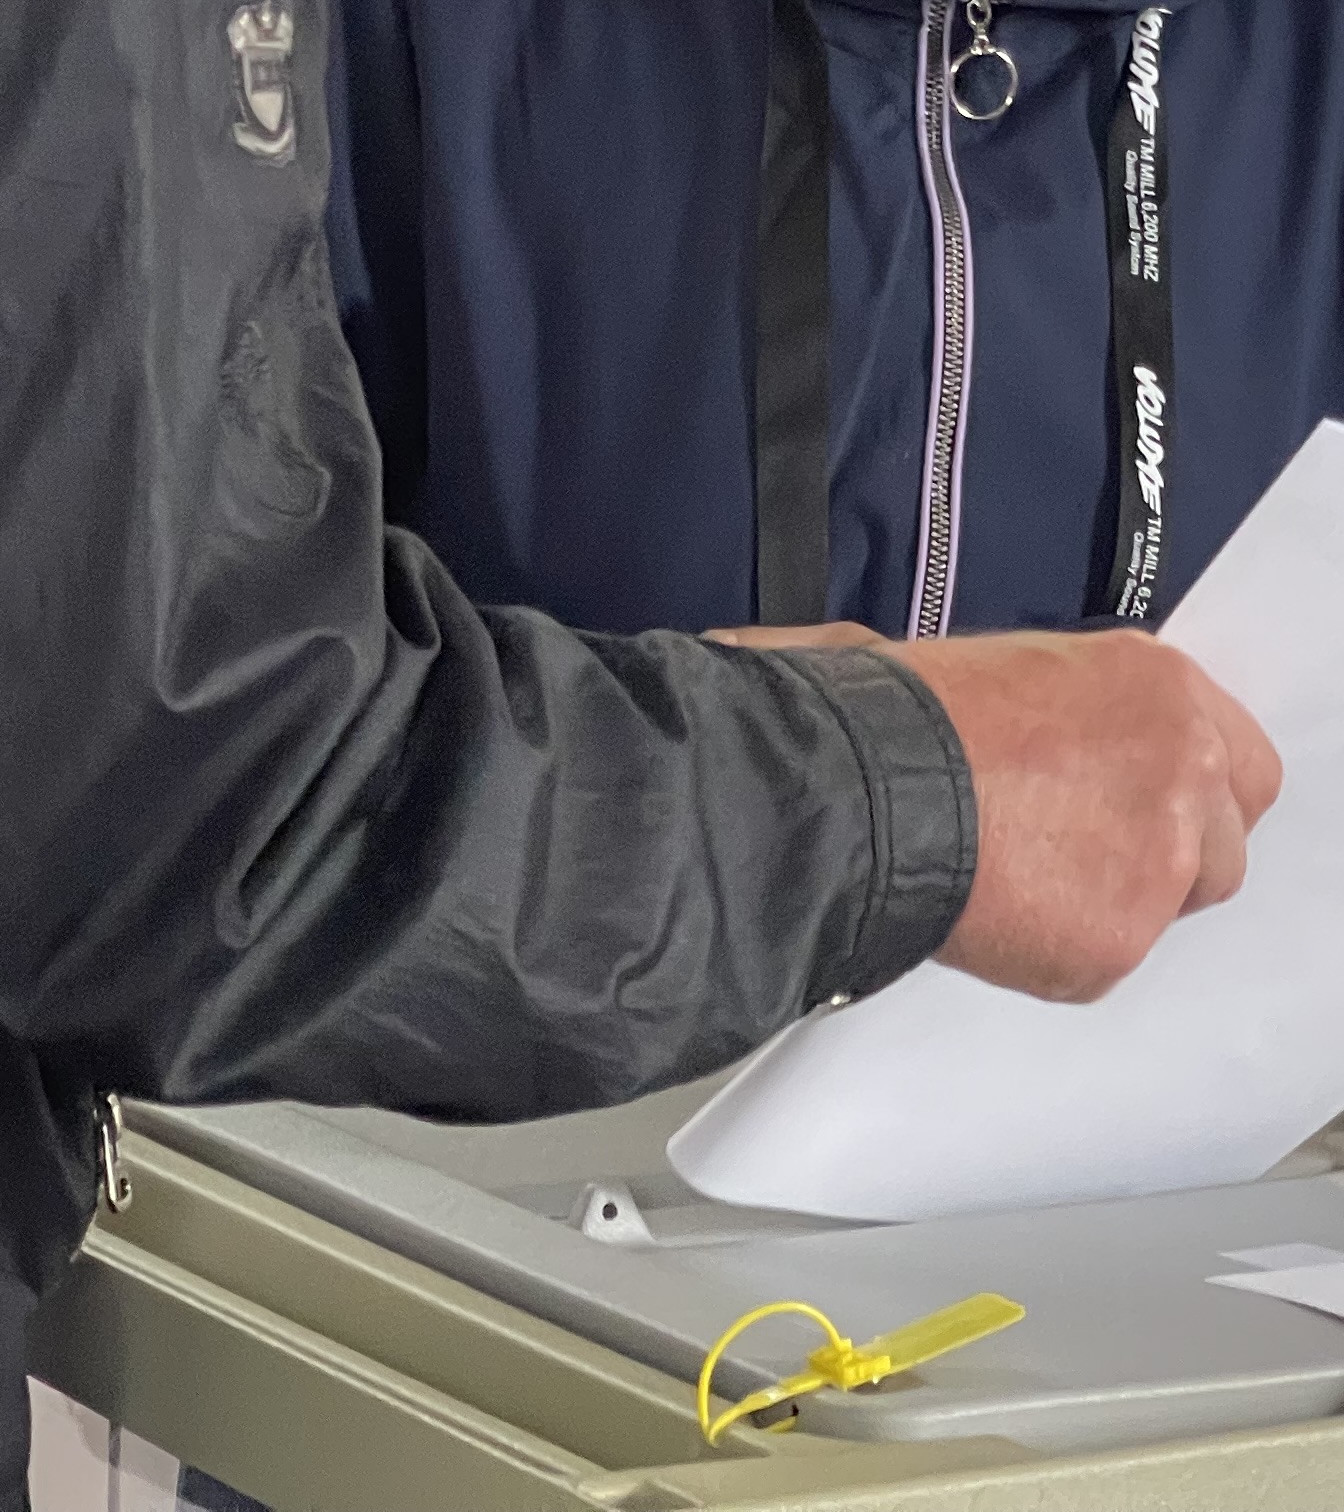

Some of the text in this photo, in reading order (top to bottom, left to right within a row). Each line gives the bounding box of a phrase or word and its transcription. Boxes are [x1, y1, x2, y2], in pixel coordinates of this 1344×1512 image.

[1140, 138, 1156, 162] TM
[1140, 163, 1156, 199] MILL
[1142, 244, 1159, 282] MHZ
[1146, 517, 1162, 543] TM
[1140, 544, 1160, 584] MILL
